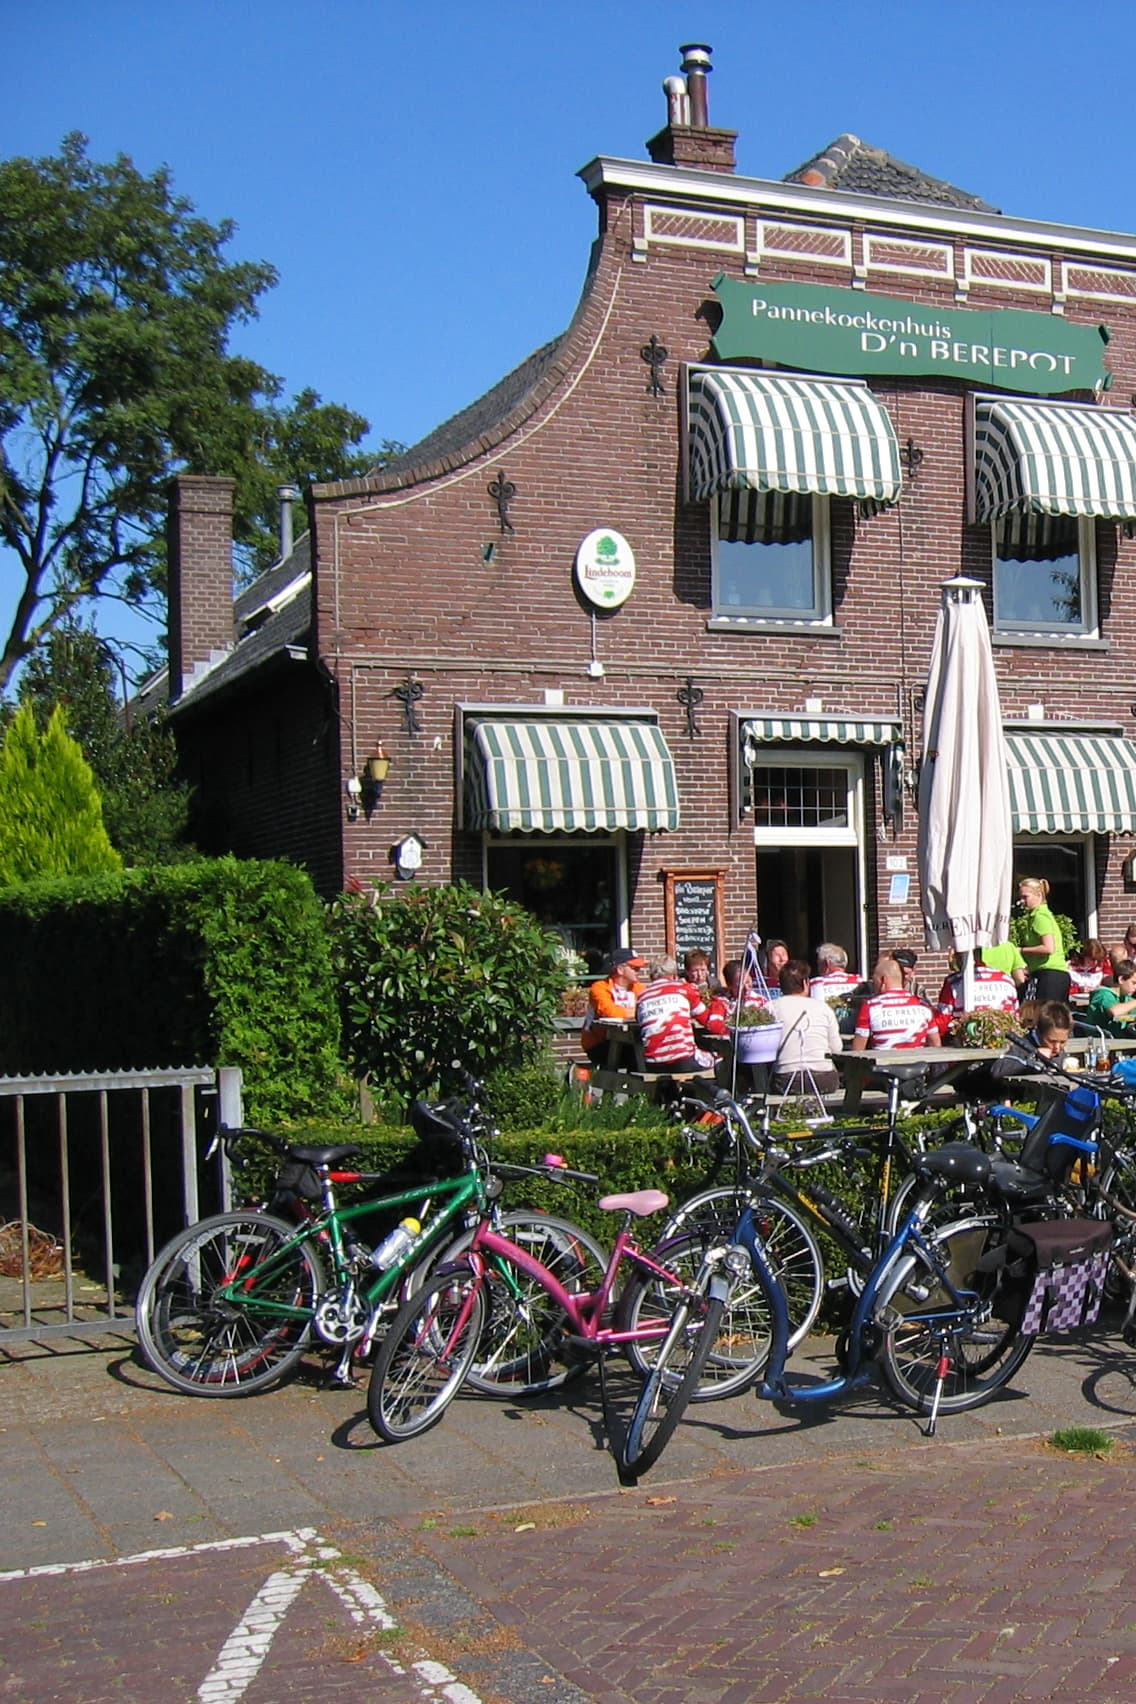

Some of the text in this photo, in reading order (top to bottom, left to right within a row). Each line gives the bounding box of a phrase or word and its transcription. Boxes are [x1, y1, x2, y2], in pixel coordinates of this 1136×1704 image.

[752, 299, 952, 339] Pannekoekenhuis
[860, 332, 1077, 375] D'n BEREPOT
[584, 564, 632, 580] Lindeboom
